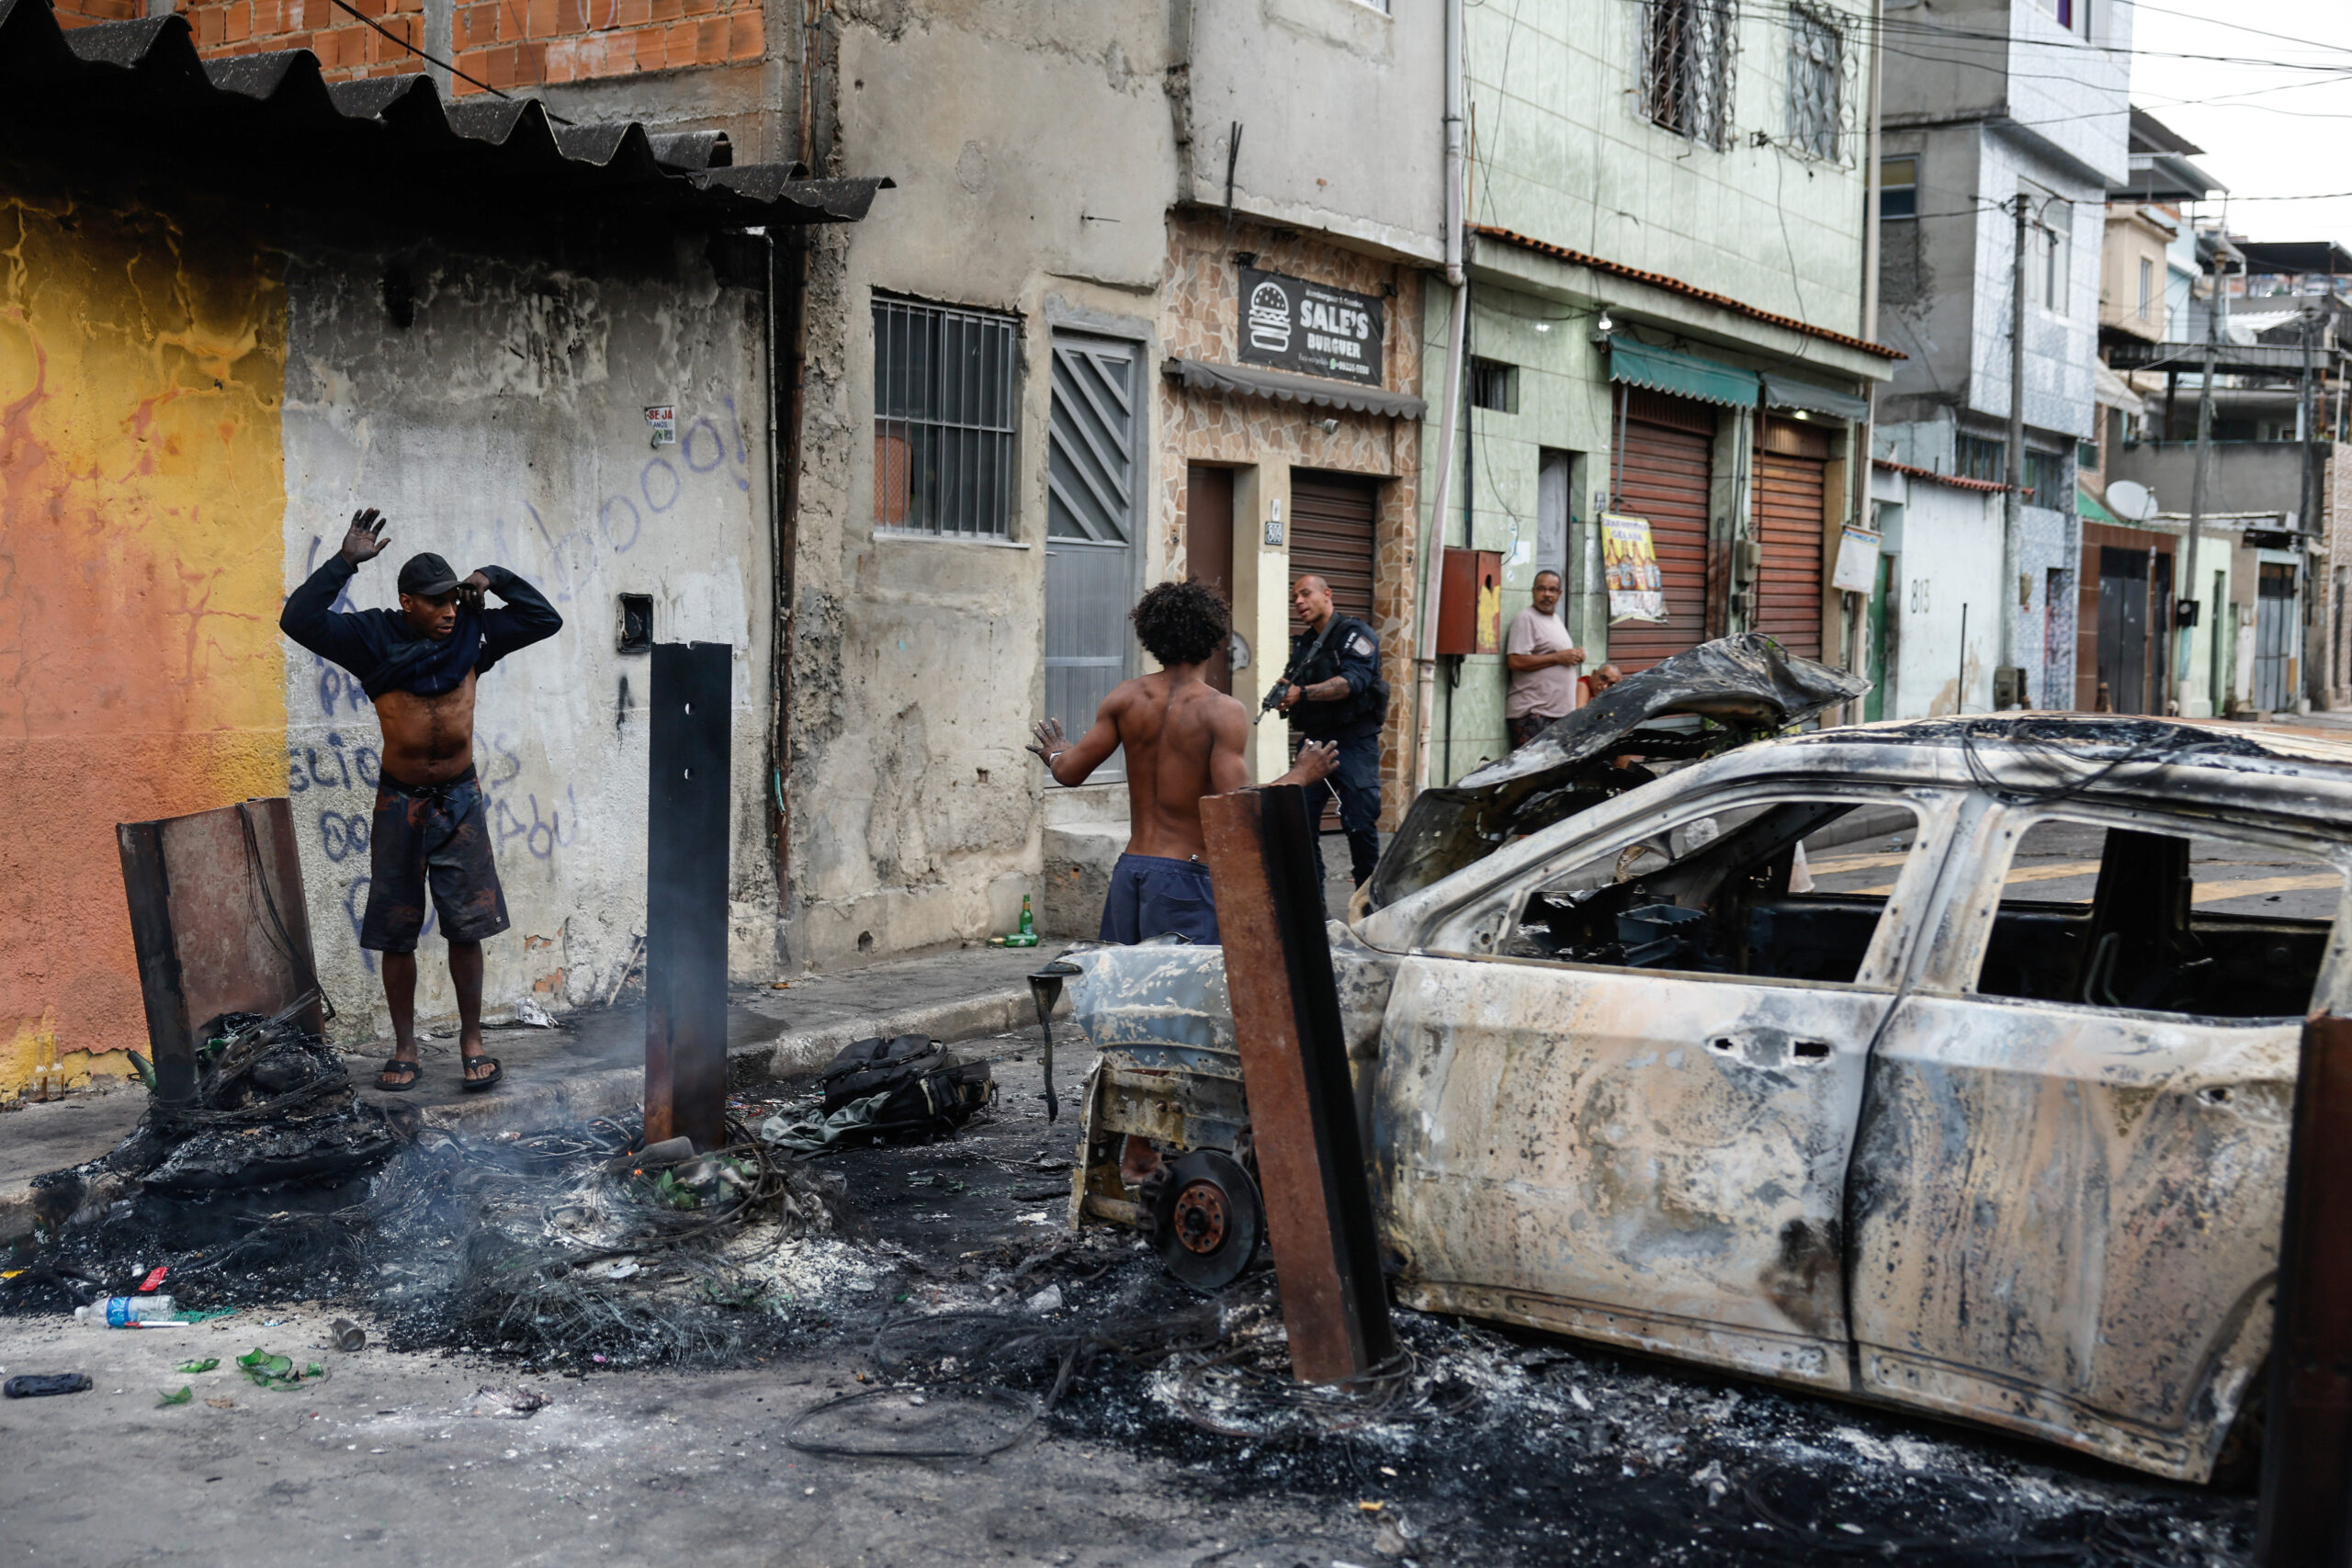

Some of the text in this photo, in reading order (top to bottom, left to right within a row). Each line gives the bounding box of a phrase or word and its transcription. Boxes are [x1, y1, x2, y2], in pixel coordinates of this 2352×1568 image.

[1300, 299, 1369, 340] SALE'S
[1307, 333, 1362, 359] BURGUER
[1910, 579, 1930, 615] 813
